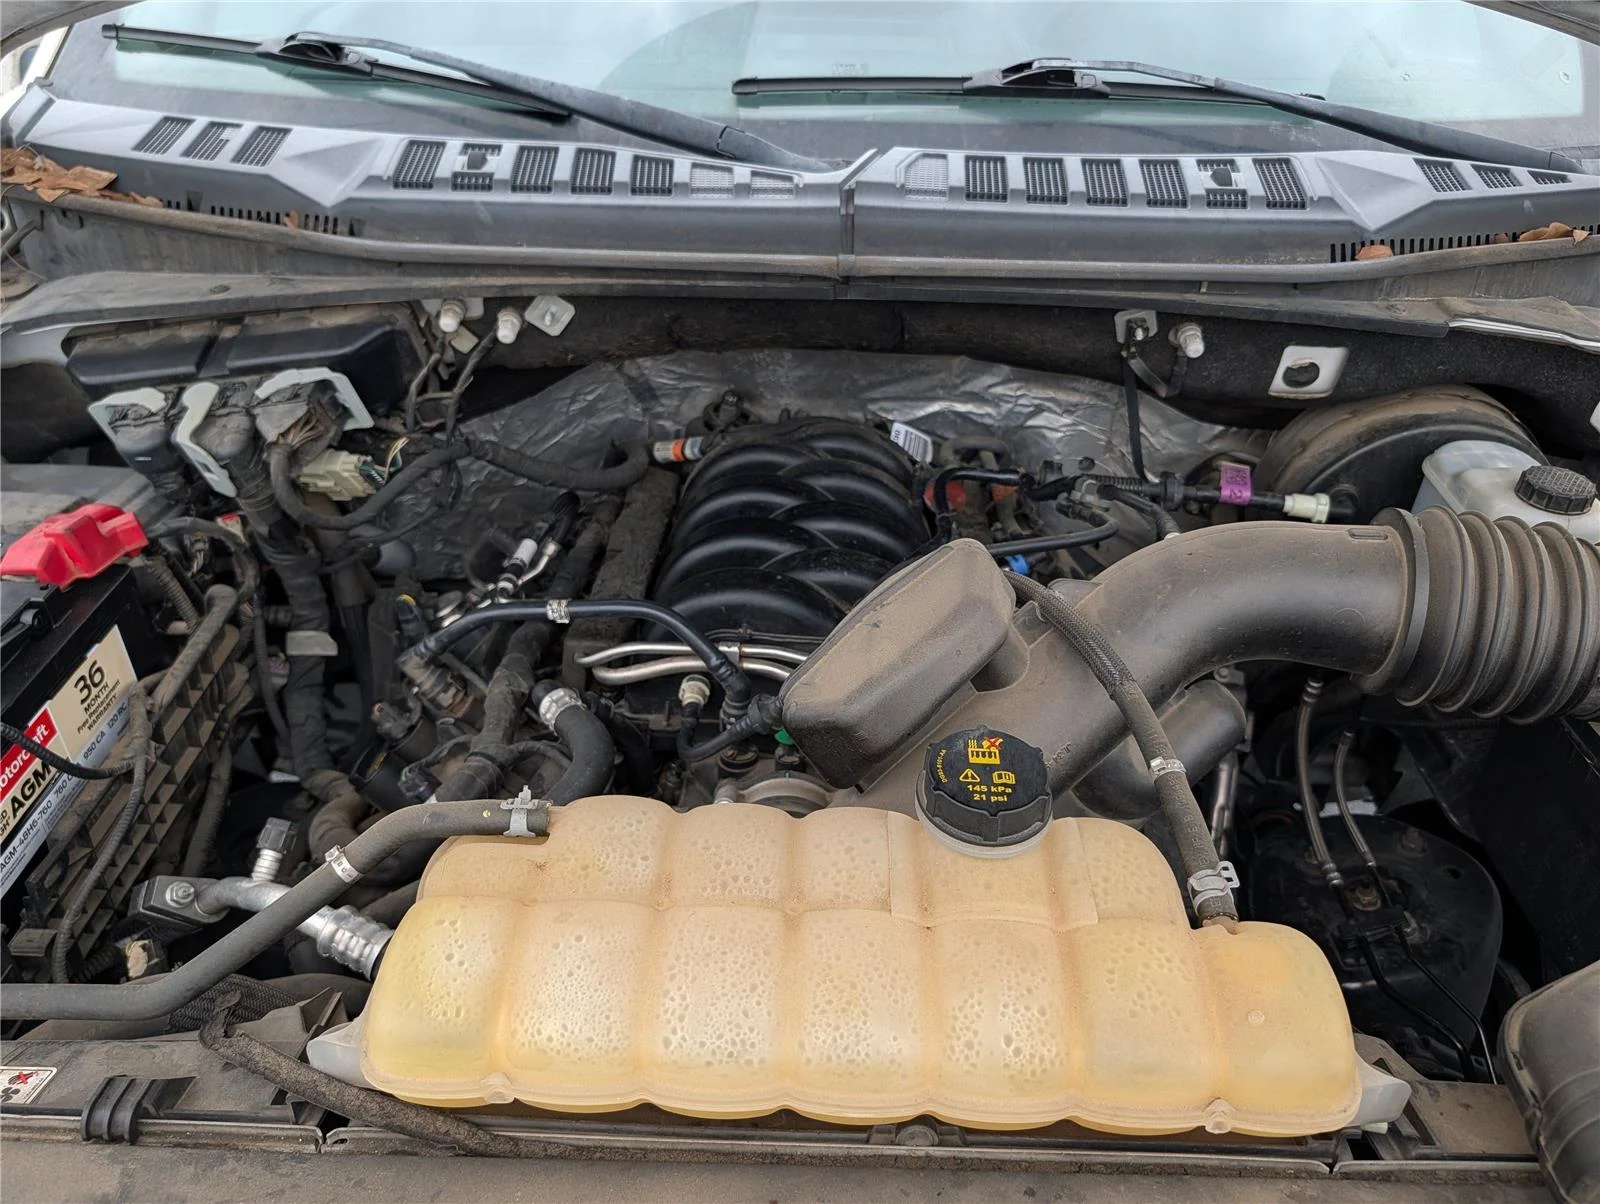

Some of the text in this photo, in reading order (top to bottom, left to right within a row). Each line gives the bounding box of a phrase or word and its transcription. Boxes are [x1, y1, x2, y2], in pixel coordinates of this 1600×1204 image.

[74, 659, 105, 705] 36
[83, 684, 110, 714] MONTH
[77, 679, 121, 734] Free Replacement
[87, 694, 118, 732] WARRANTY
[83, 742, 98, 761] 950
[95, 730, 107, 746] CA
[106, 715, 120, 731] 120
[116, 702, 129, 719] RC
[10, 757, 51, 820] AGM
[54, 782, 68, 800] 760
[967, 785, 1012, 793] 145 kPa
[973, 793, 1008, 803] 21 psi
